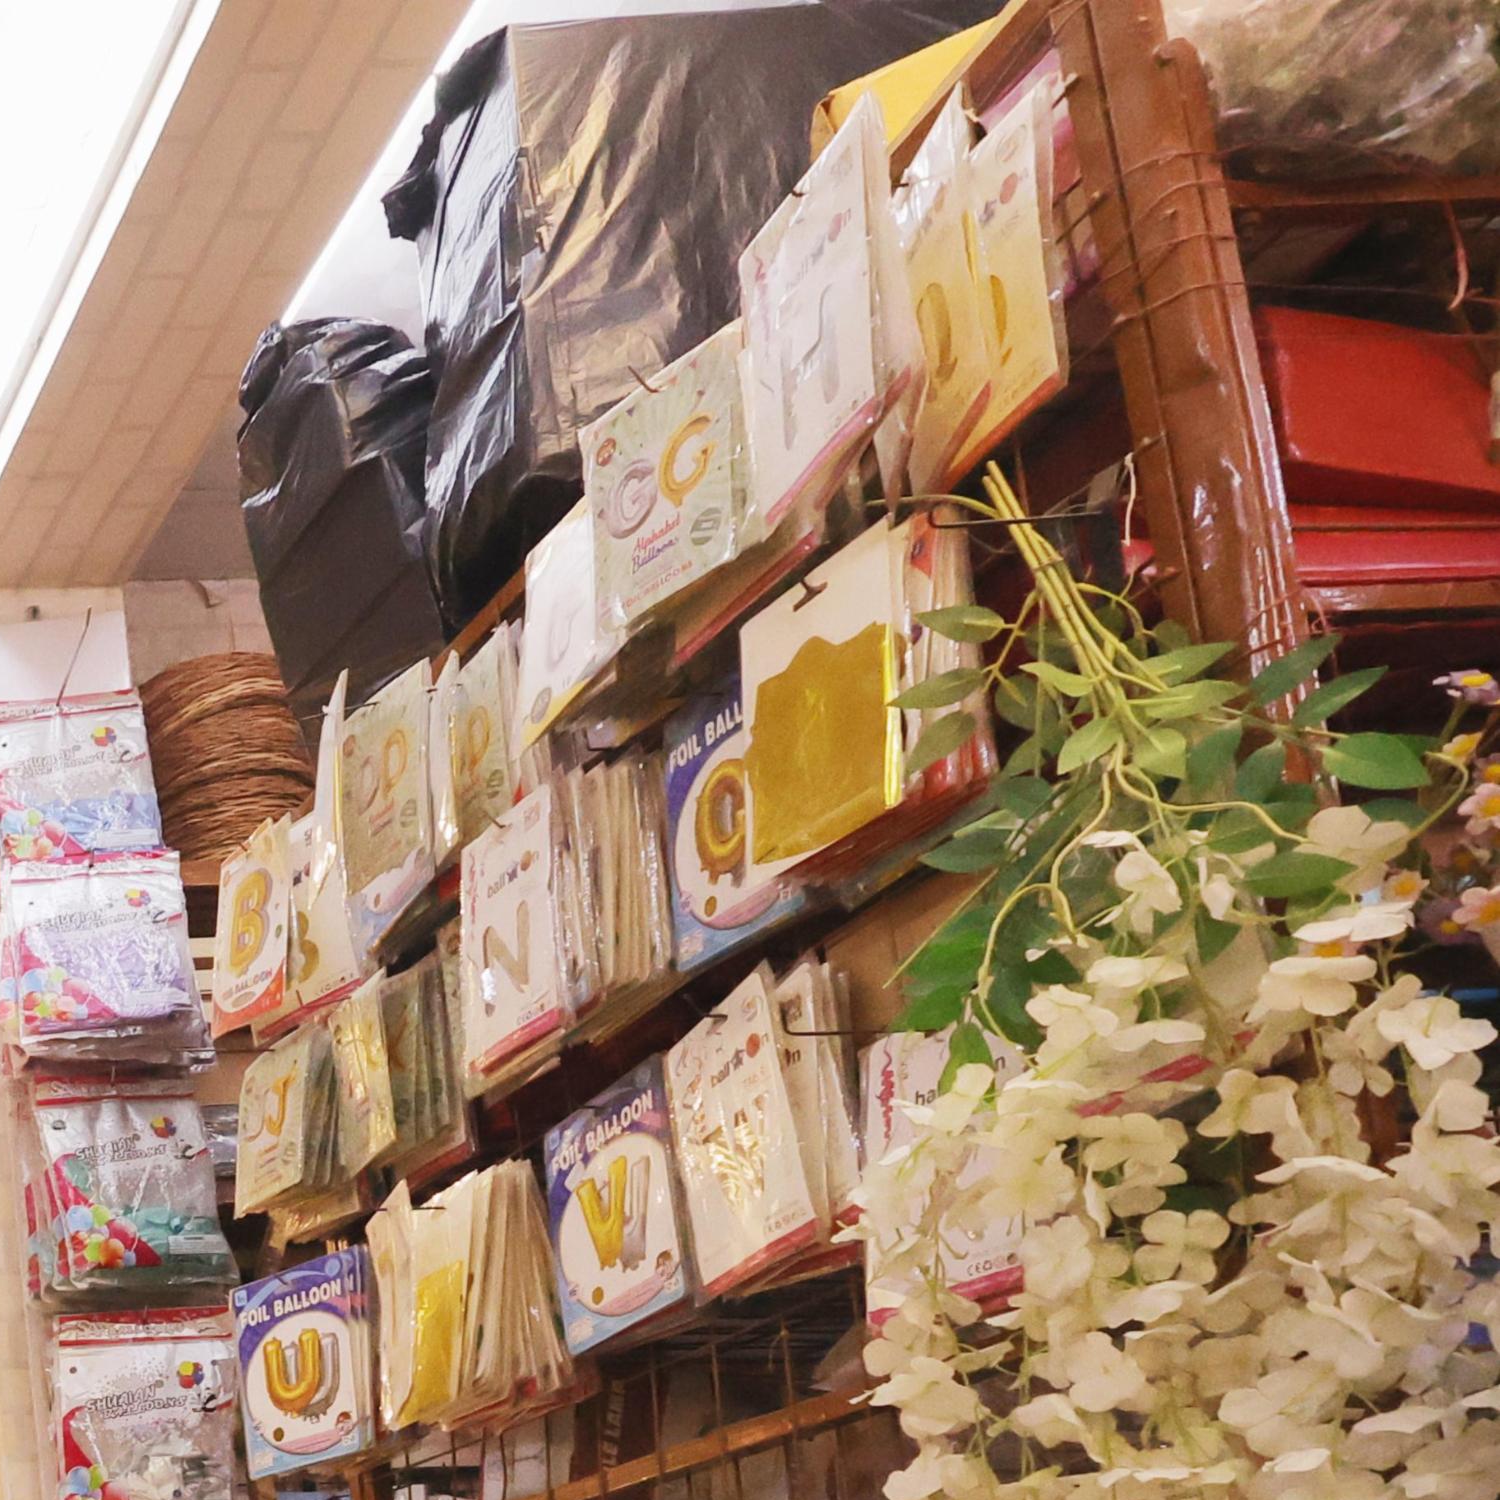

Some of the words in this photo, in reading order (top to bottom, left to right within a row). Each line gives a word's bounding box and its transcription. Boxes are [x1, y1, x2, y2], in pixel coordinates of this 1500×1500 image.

[668, 734, 701, 774] FOIL
[704, 702, 744, 741] BALL
[552, 1138, 584, 1176] FOIL
[585, 1089, 653, 1153] BALLOON
[239, 1307, 271, 1330] FOIL
[273, 1277, 342, 1317] BALLOON
